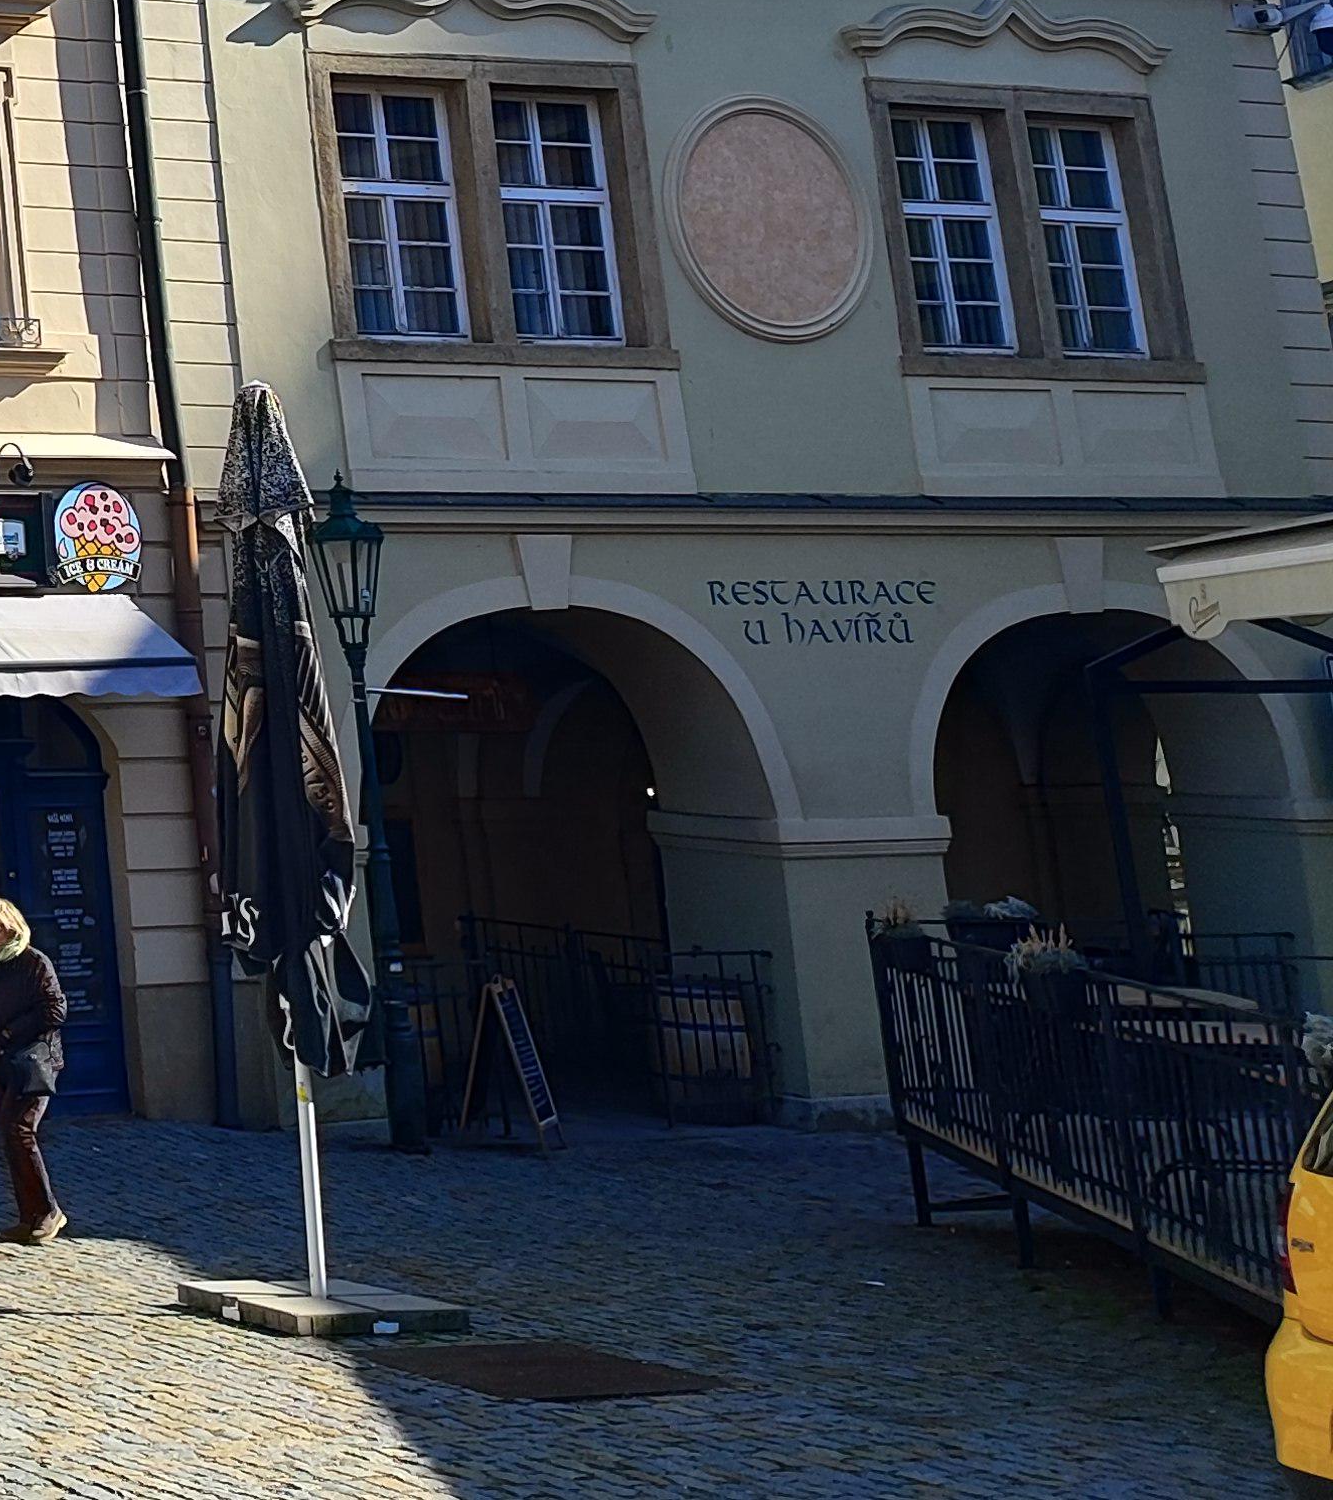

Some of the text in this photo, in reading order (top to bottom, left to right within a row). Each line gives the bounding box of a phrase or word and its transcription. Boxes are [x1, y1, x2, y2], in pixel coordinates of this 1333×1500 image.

[63, 561, 84, 577] ICE
[96, 558, 134, 576] CREAM
[706, 580, 936, 606] RESTAURACE
